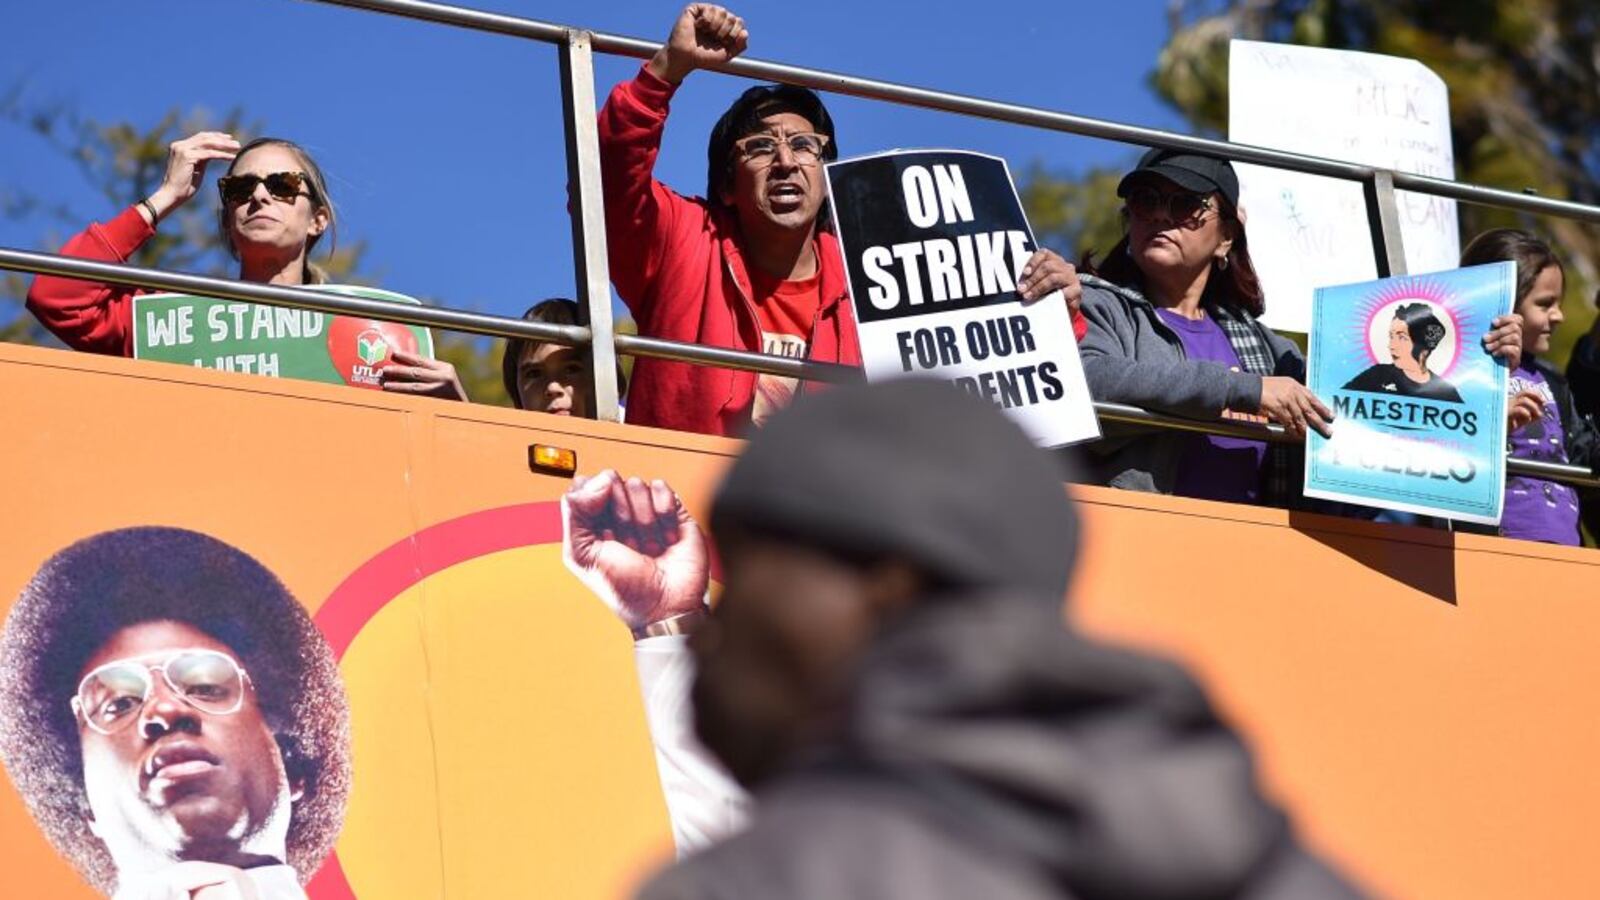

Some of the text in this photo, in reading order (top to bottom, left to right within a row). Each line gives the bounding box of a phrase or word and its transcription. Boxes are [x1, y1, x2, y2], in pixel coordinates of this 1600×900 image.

[901, 163, 975, 229] ON
[861, 230, 1034, 310] STRIKE
[146, 303, 325, 347] WE STAND
[896, 314, 1036, 372] FOR OUR
[951, 361, 1064, 409] DENTS
[1332, 394, 1478, 437] MAESTROS
